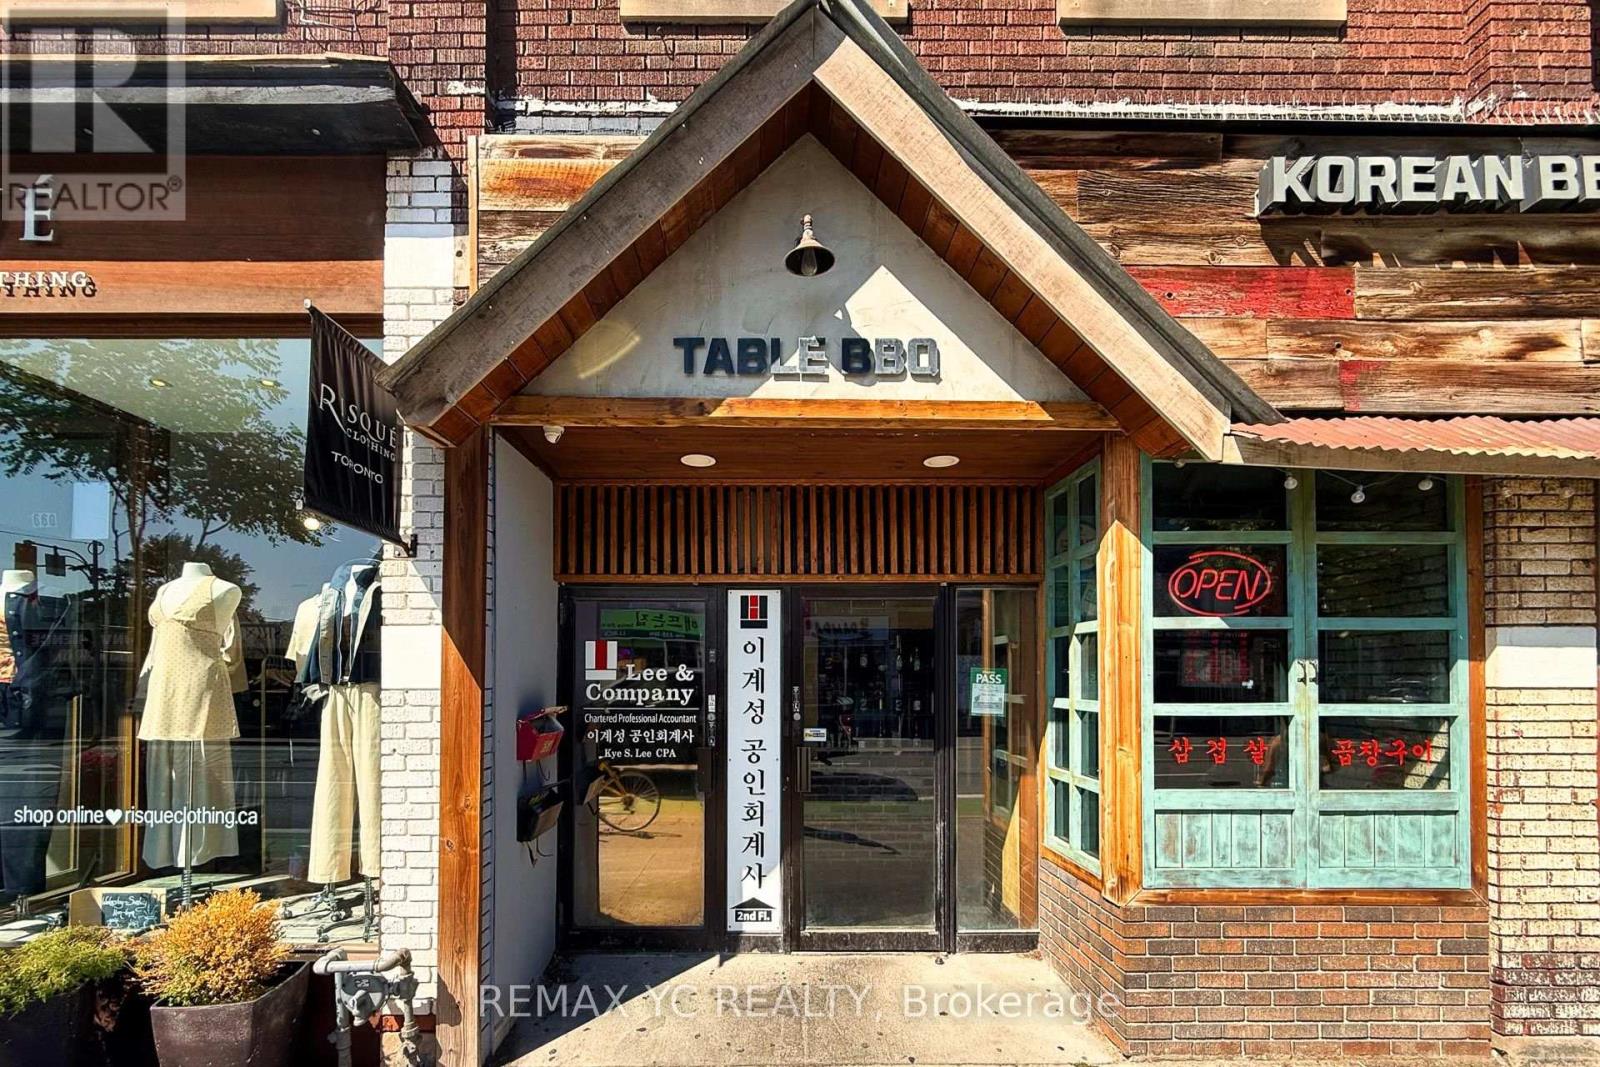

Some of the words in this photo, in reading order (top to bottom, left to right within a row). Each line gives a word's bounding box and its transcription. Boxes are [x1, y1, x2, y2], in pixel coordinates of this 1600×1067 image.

[1271, 155, 1525, 202] KOREAN
[673, 337, 827, 375] TABLE
[842, 337, 941, 377] BBQ
[319, 383, 397, 448] RISQUÉ
[346, 428, 396, 462] CLOTHING
[331, 451, 384, 484] TORONTO
[1173, 568, 1261, 601] OPEN
[625, 664, 668, 681] Lee
[675, 664, 694, 681] &
[742, 636, 766, 725] 이계성
[976, 673, 1002, 684] PASS
[585, 683, 694, 706] Company
[584, 713, 617, 723] Chartered
[618, 713, 658, 723] Professional
[659, 713, 697, 723] Accountant
[587, 729, 625, 743] 이계성
[629, 729, 695, 743] 공인회계사
[604, 748, 622, 759] Kye
[624, 748, 633, 758] S.
[635, 748, 652, 758] Lee
[656, 748, 677, 758] CPA
[14, 805, 54, 828] shop
[56, 805, 104, 824] online
[124, 805, 258, 829] risqueclothing.ca
[740, 739, 768, 889] 공인회계사
[737, 911, 756, 921] 2nd
